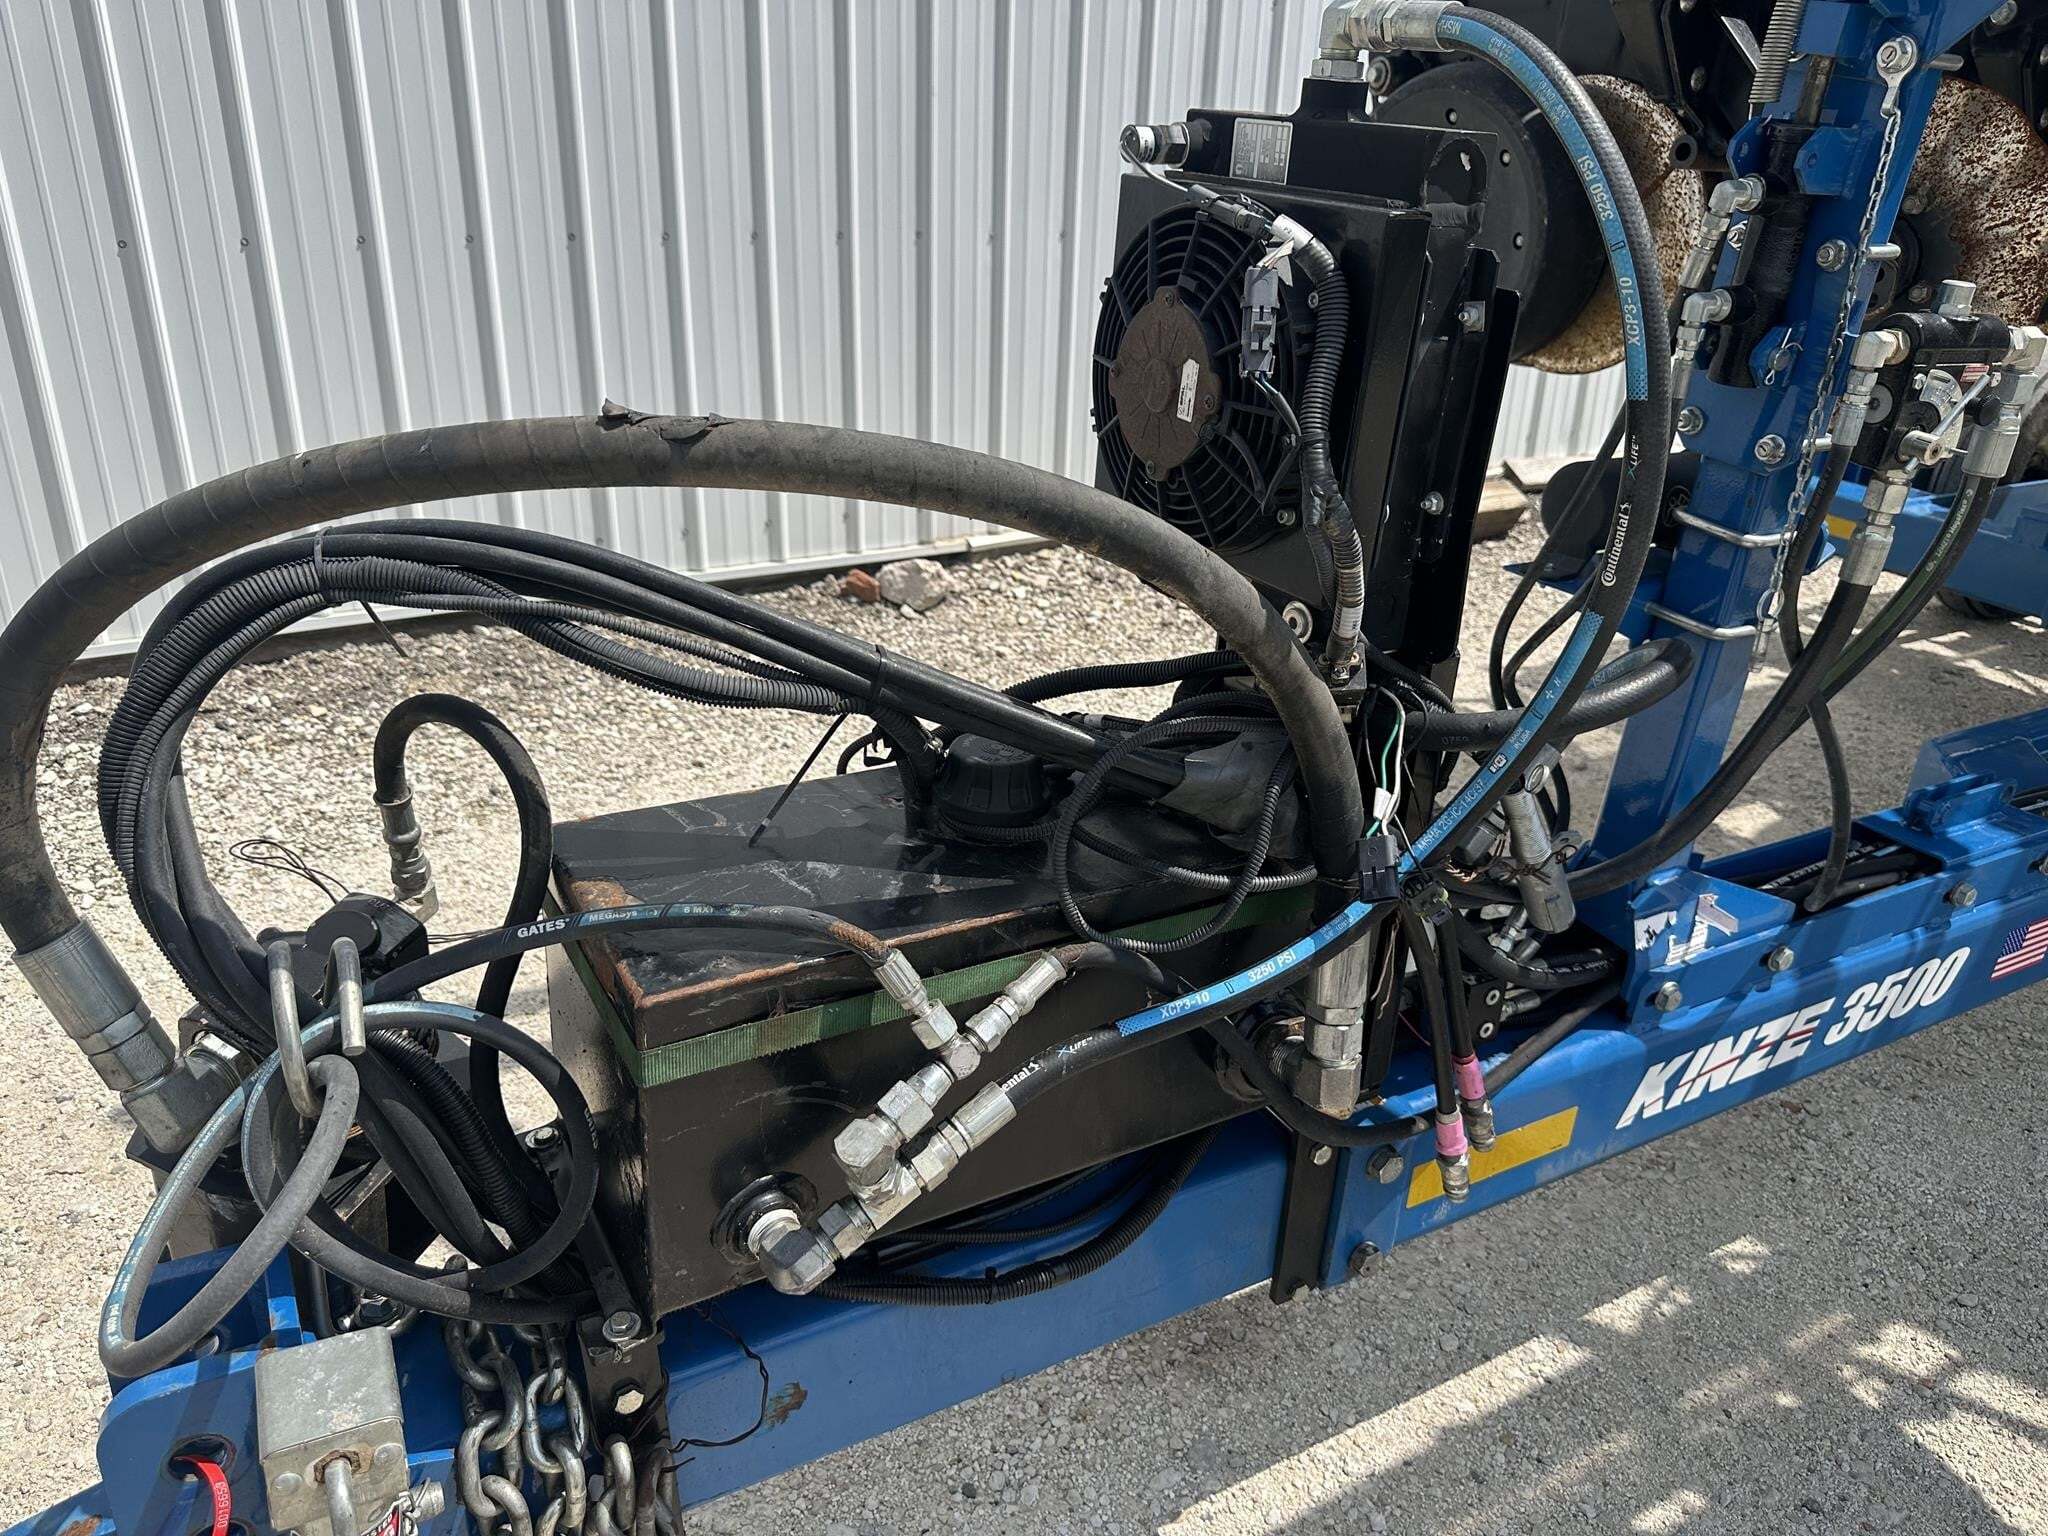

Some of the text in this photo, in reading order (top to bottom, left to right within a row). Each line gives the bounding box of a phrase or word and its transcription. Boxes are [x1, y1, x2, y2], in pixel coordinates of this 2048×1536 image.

[1576, 154, 1641, 345] XCP3-10 3250 PSI
[1601, 512, 1630, 587] Continental
[1416, 824, 1443, 852] MSHA
[517, 918, 566, 939] GATES
[1160, 950, 1298, 1019] XCP3-10 3250 PSI
[1615, 946, 1972, 1131] KINZE 3500
